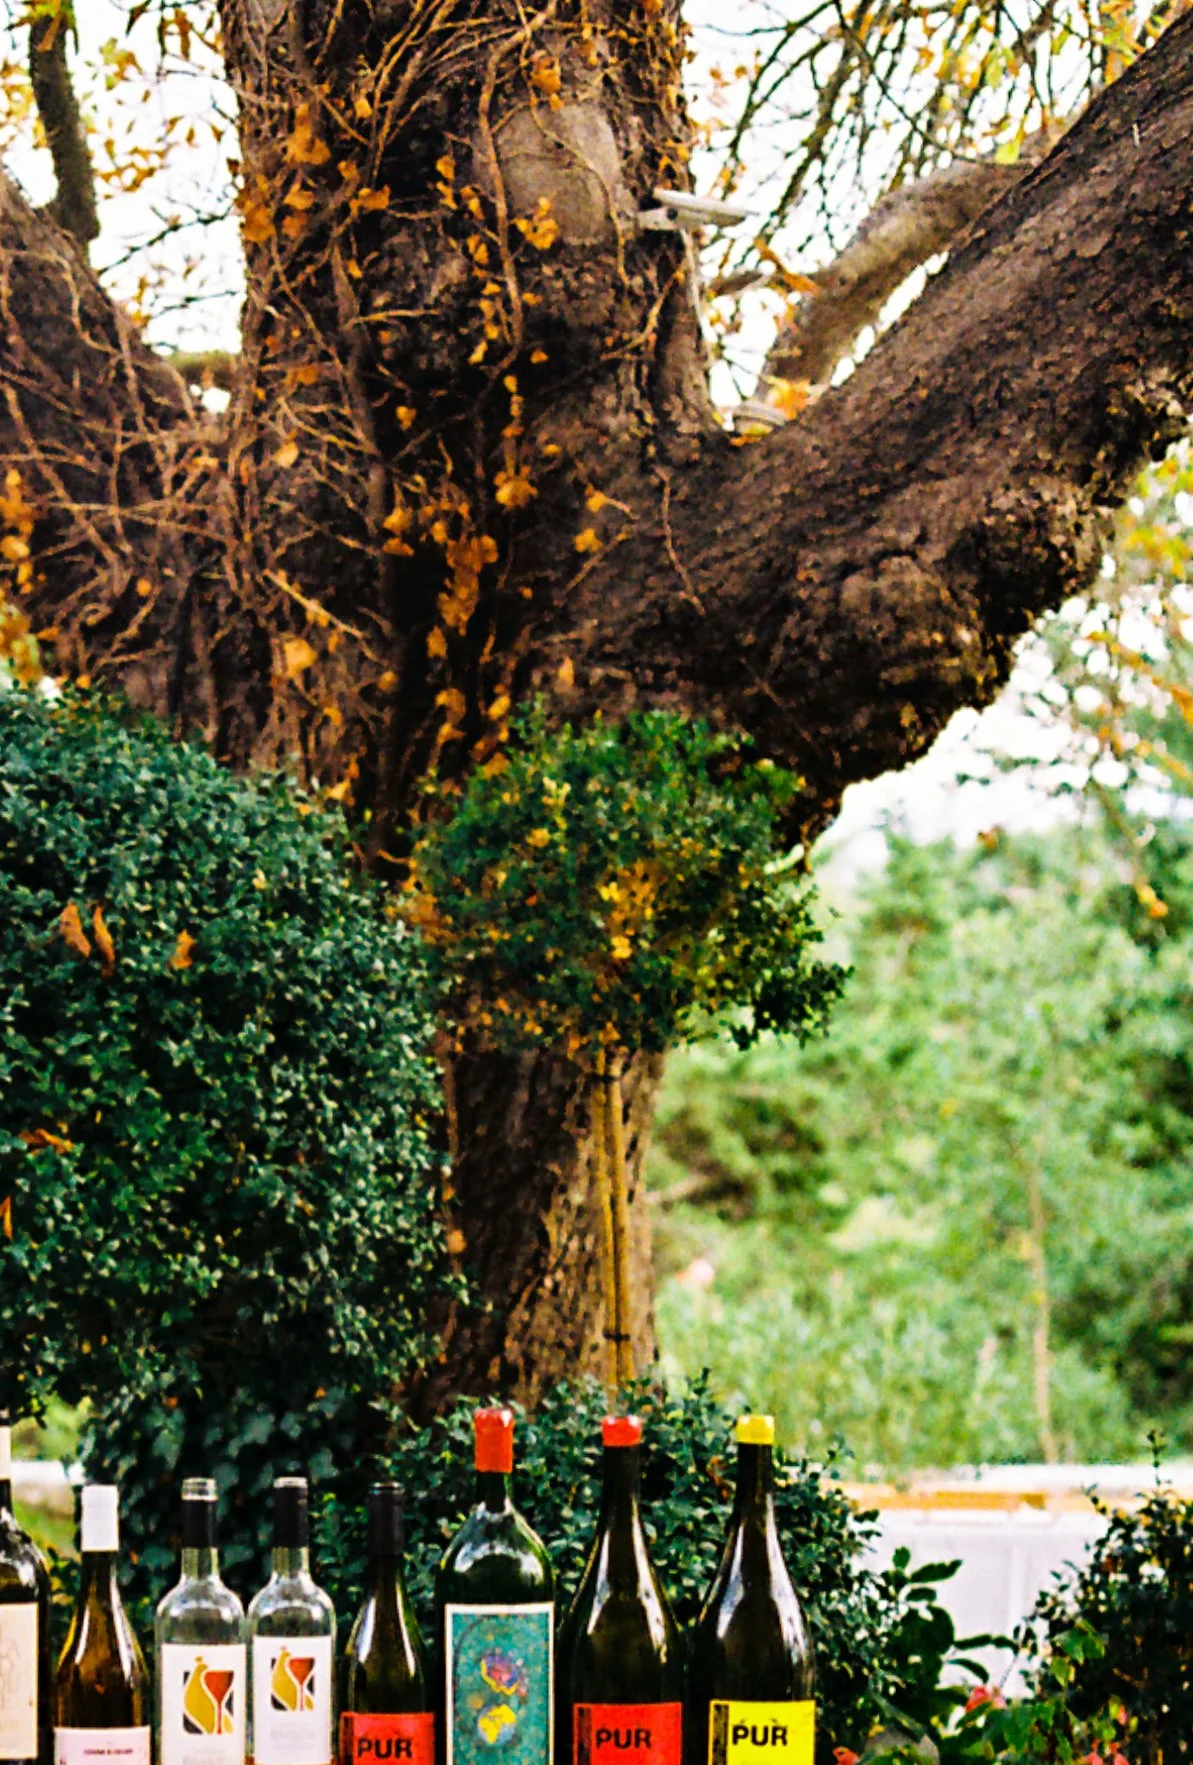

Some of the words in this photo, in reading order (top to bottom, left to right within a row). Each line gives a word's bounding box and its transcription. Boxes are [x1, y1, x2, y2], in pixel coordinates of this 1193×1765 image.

[596, 1728, 652, 1750] PUR
[731, 1724, 788, 1747] PUR
[358, 1737, 413, 1759] PUR
